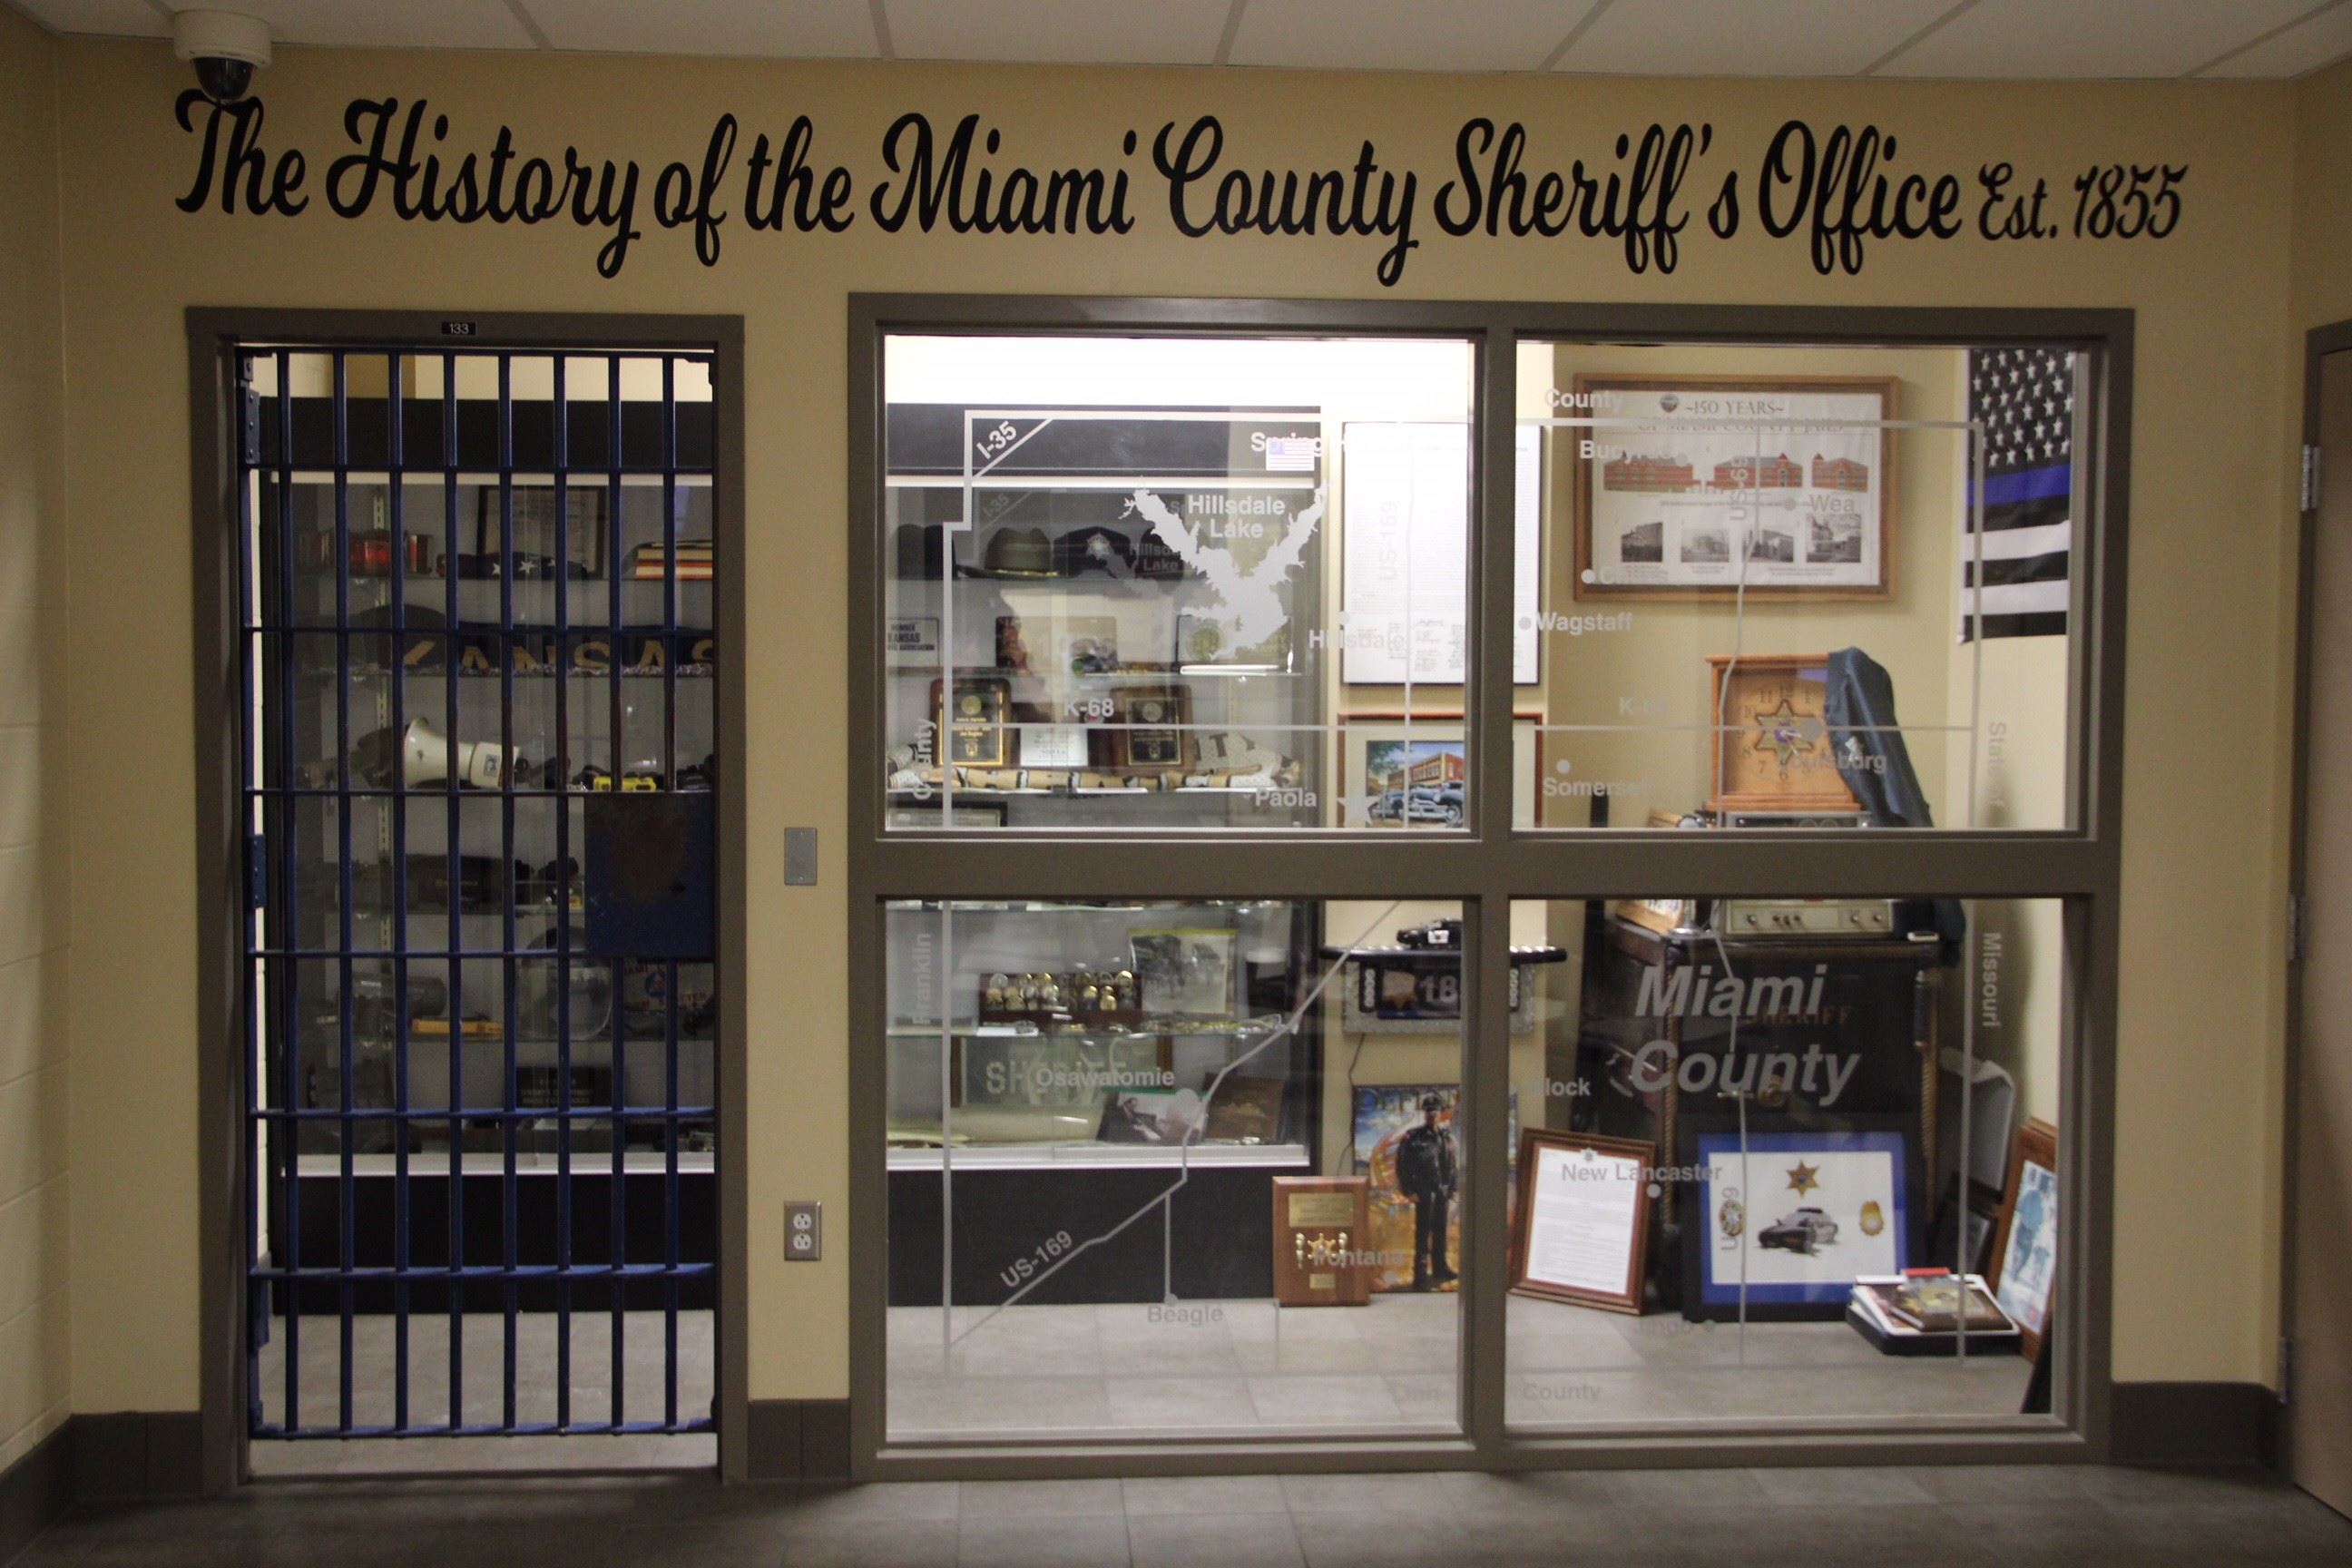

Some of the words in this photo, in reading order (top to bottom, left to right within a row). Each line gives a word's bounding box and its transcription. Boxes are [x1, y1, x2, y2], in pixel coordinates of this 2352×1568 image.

[174, 88, 309, 216] The
[326, 97, 641, 279] History
[653, 112, 738, 268] of
[743, 114, 855, 233] the
[870, 112, 1137, 235] Miami
[1152, 114, 1418, 288] County
[1434, 117, 1740, 275] Sheriff's
[1758, 119, 1963, 276] Office
[1978, 162, 2059, 240] Est.
[2074, 163, 2189, 240] 1855
[449, 322, 470, 336] 133
[1543, 388, 1623, 414] County
[975, 420, 1018, 460] I-35
[1187, 495, 1286, 515] Hillsdale
[1809, 494, 1856, 514] Wea
[1210, 518, 1264, 538] Lake
[1378, 500, 1399, 581] US-169
[1536, 612, 1634, 636] Wagstaff
[1063, 698, 1115, 718] K-68
[1254, 789, 1318, 808] Paola
[912, 933, 931, 1025] Franklin
[1634, 964, 1829, 1018] Miami
[1982, 932, 2003, 1027] Missouri
[1035, 1066, 1176, 1087] Osawatomie
[1630, 1039, 1862, 1107] County
[1529, 1077, 1591, 1096] lock
[1562, 1163, 1608, 1181] New
[1615, 1163, 1723, 1182] Lancaster
[999, 1230, 1074, 1288] US-169
[1147, 1305, 1224, 1328] Beagle
[1520, 1381, 1602, 1406] County
